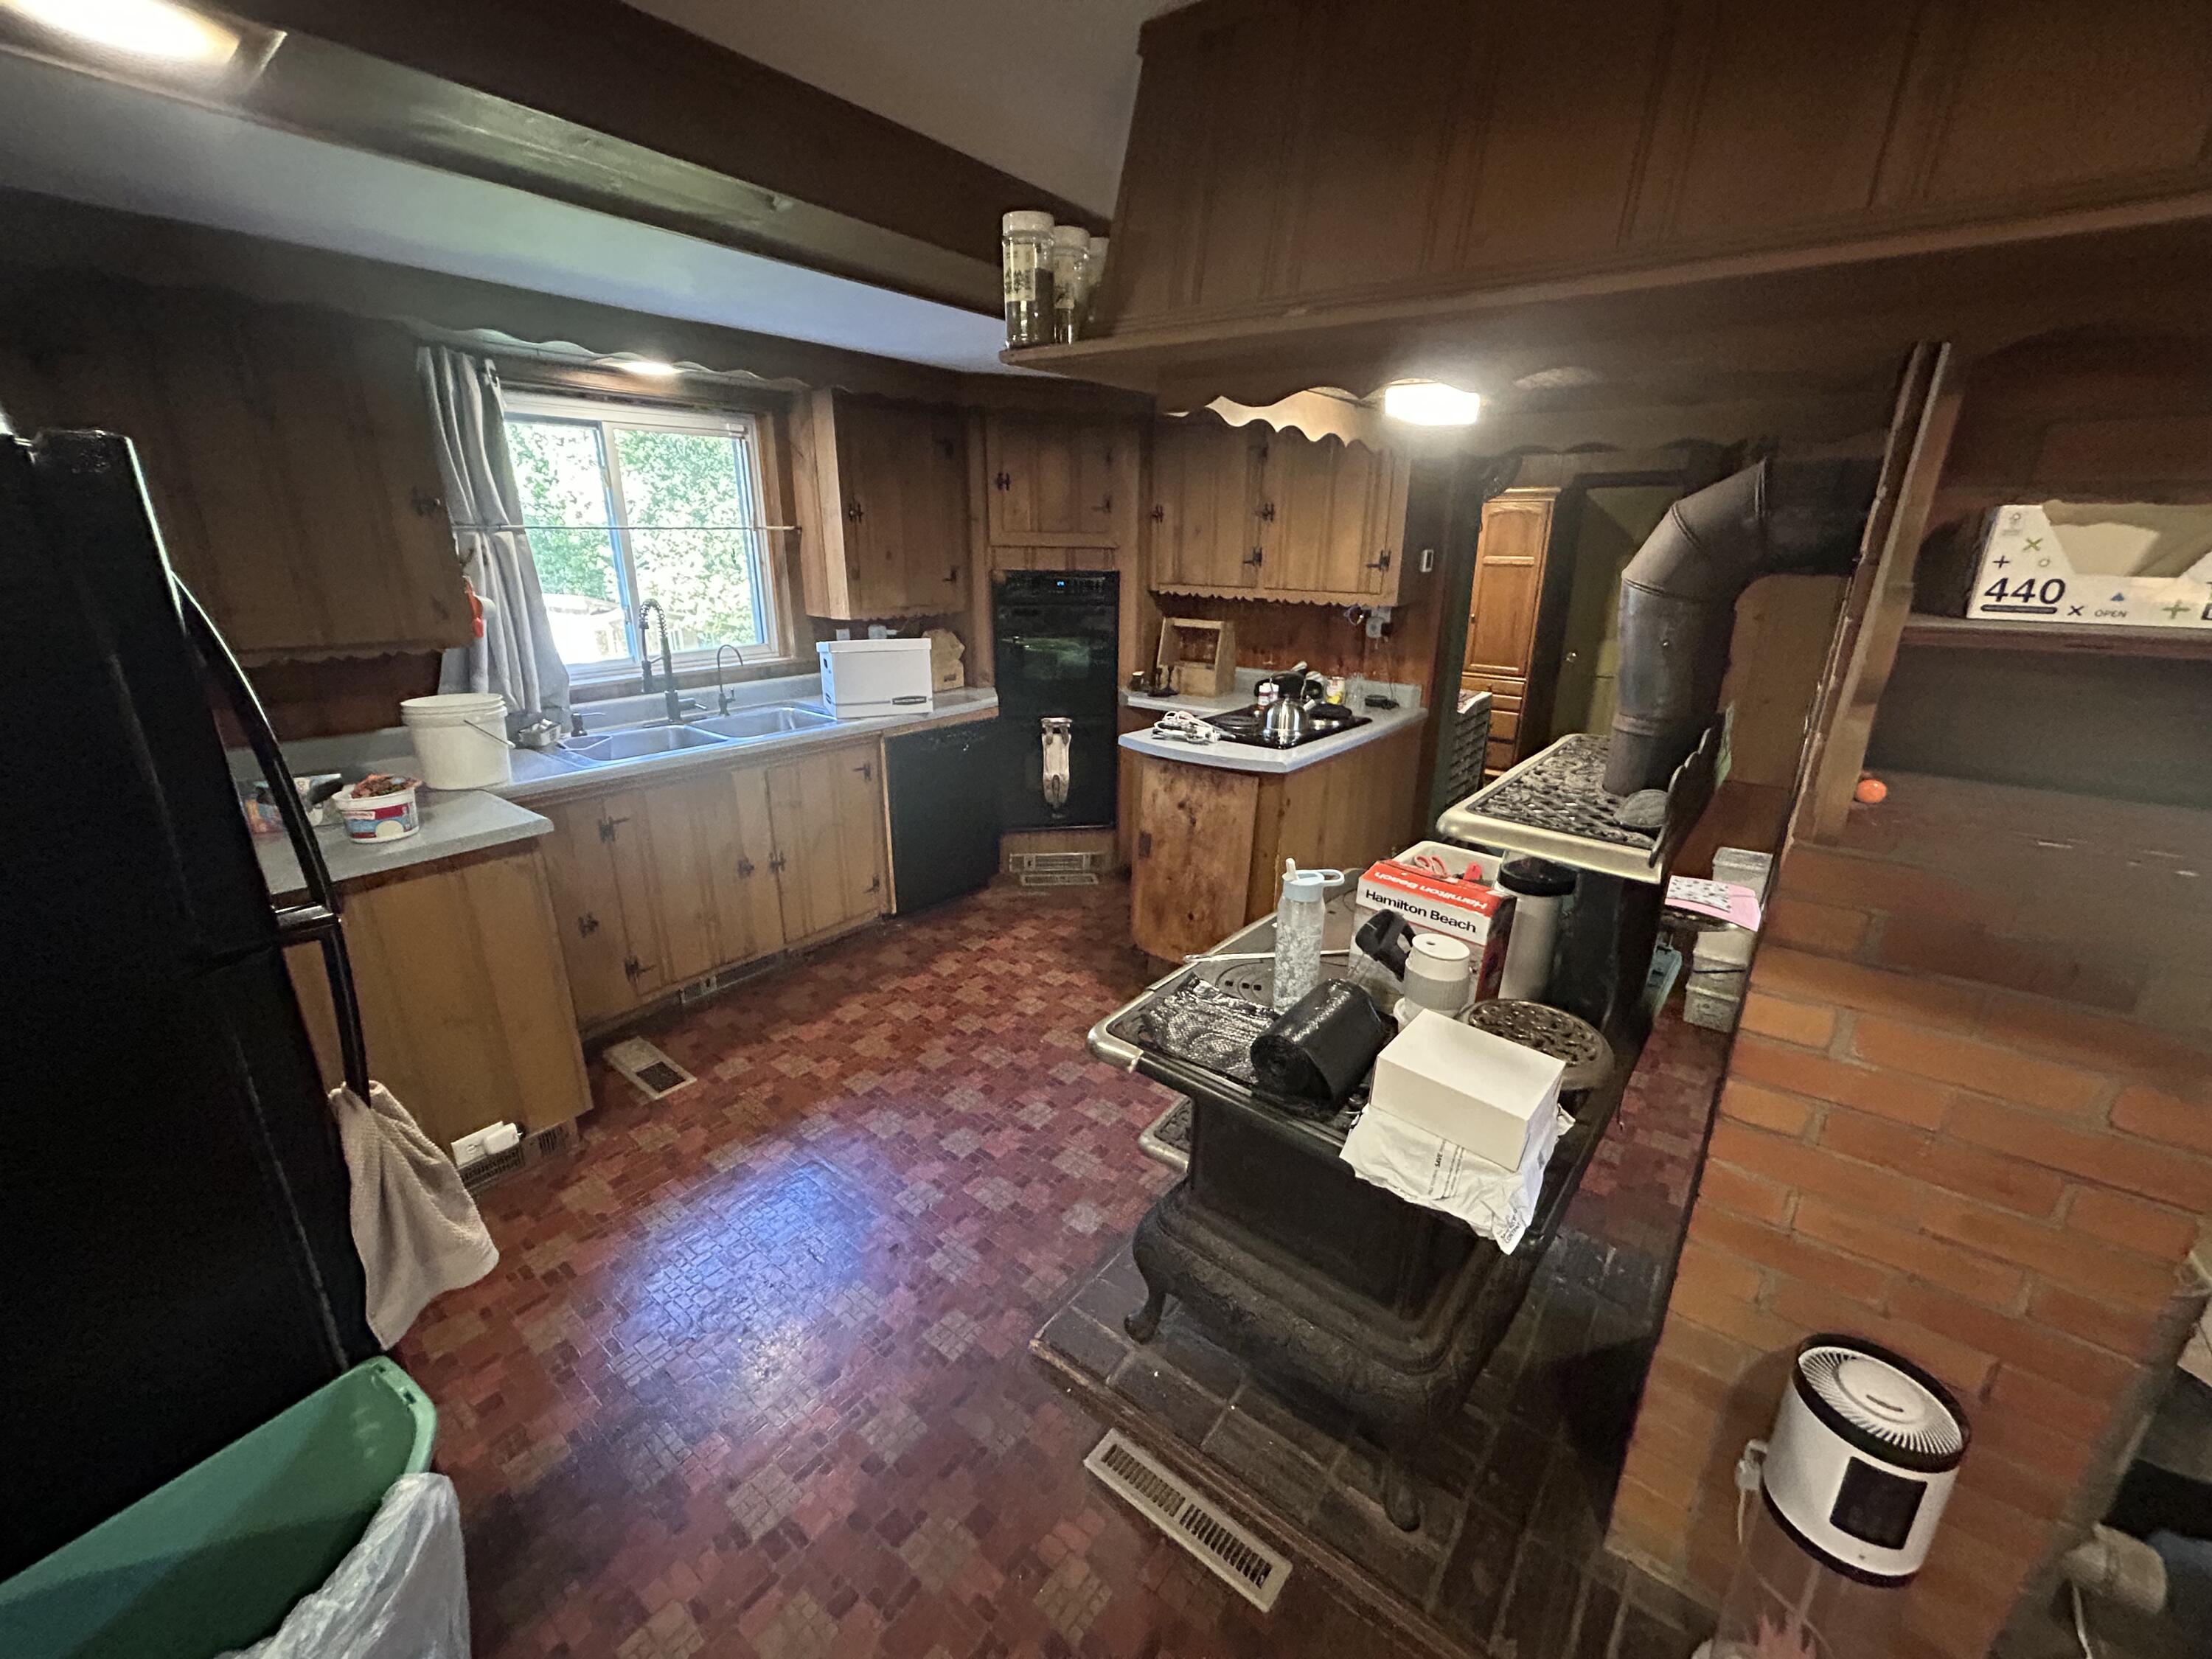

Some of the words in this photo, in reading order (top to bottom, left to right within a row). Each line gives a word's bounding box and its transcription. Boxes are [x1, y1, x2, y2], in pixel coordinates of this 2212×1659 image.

[1984, 577, 2066, 605] 440
[2094, 609, 2128, 618] OPEN
[1374, 872, 1419, 889] Beach
[1419, 885, 1487, 909] Hamilton
[1366, 889, 1427, 917] Hamilton
[1430, 910, 1476, 933] Beach
